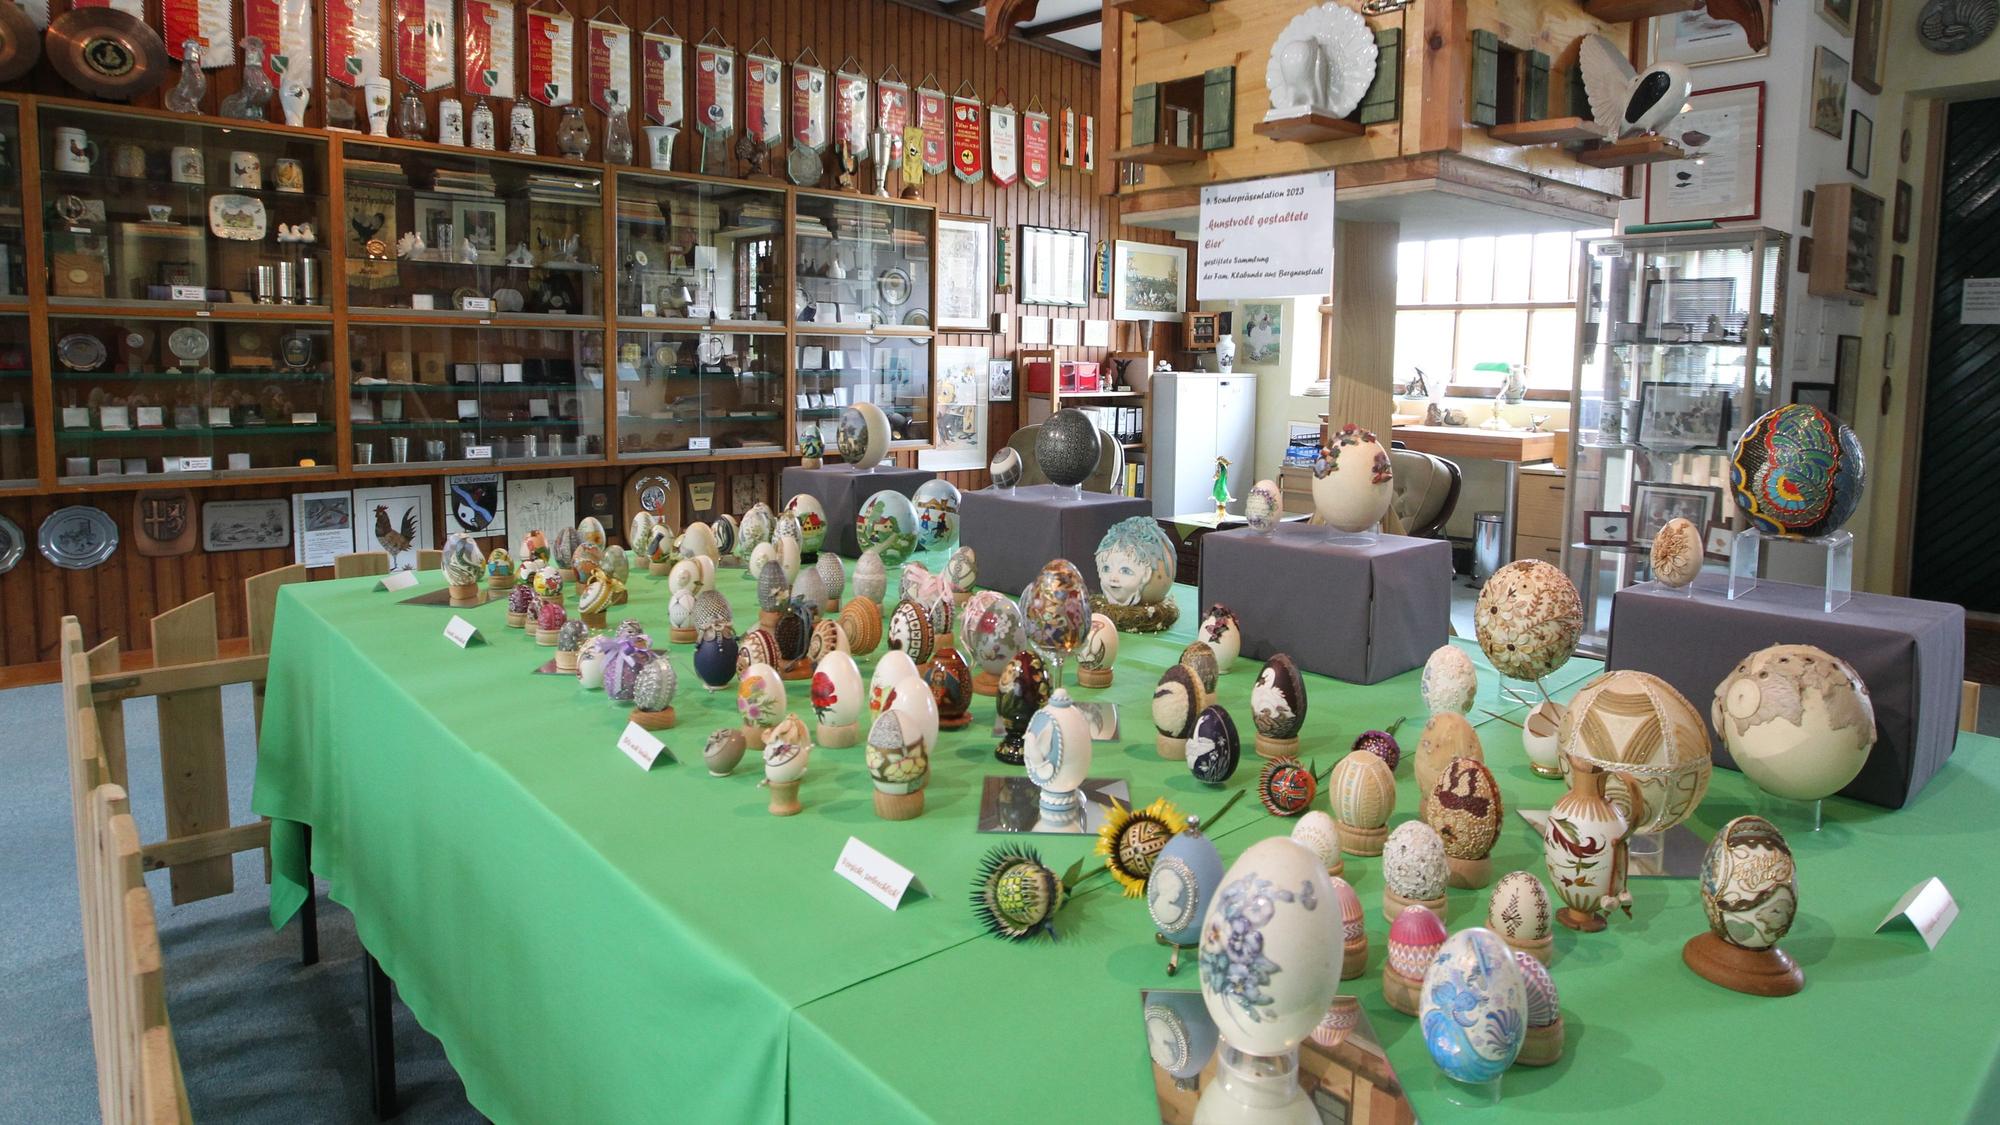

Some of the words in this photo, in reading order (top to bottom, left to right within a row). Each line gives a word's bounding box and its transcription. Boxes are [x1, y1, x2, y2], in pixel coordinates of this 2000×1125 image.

[1213, 191, 1284, 204] Sonderpräsentation
[1286, 187, 1305, 197] 2023
[1257, 211, 1309, 228] gestaltete
[1203, 257, 1232, 267] gestiftete
[1233, 255, 1269, 265] Sammlung
[1230, 270, 1263, 279] Klabunde
[1278, 267, 1324, 279] Bergneustadt
